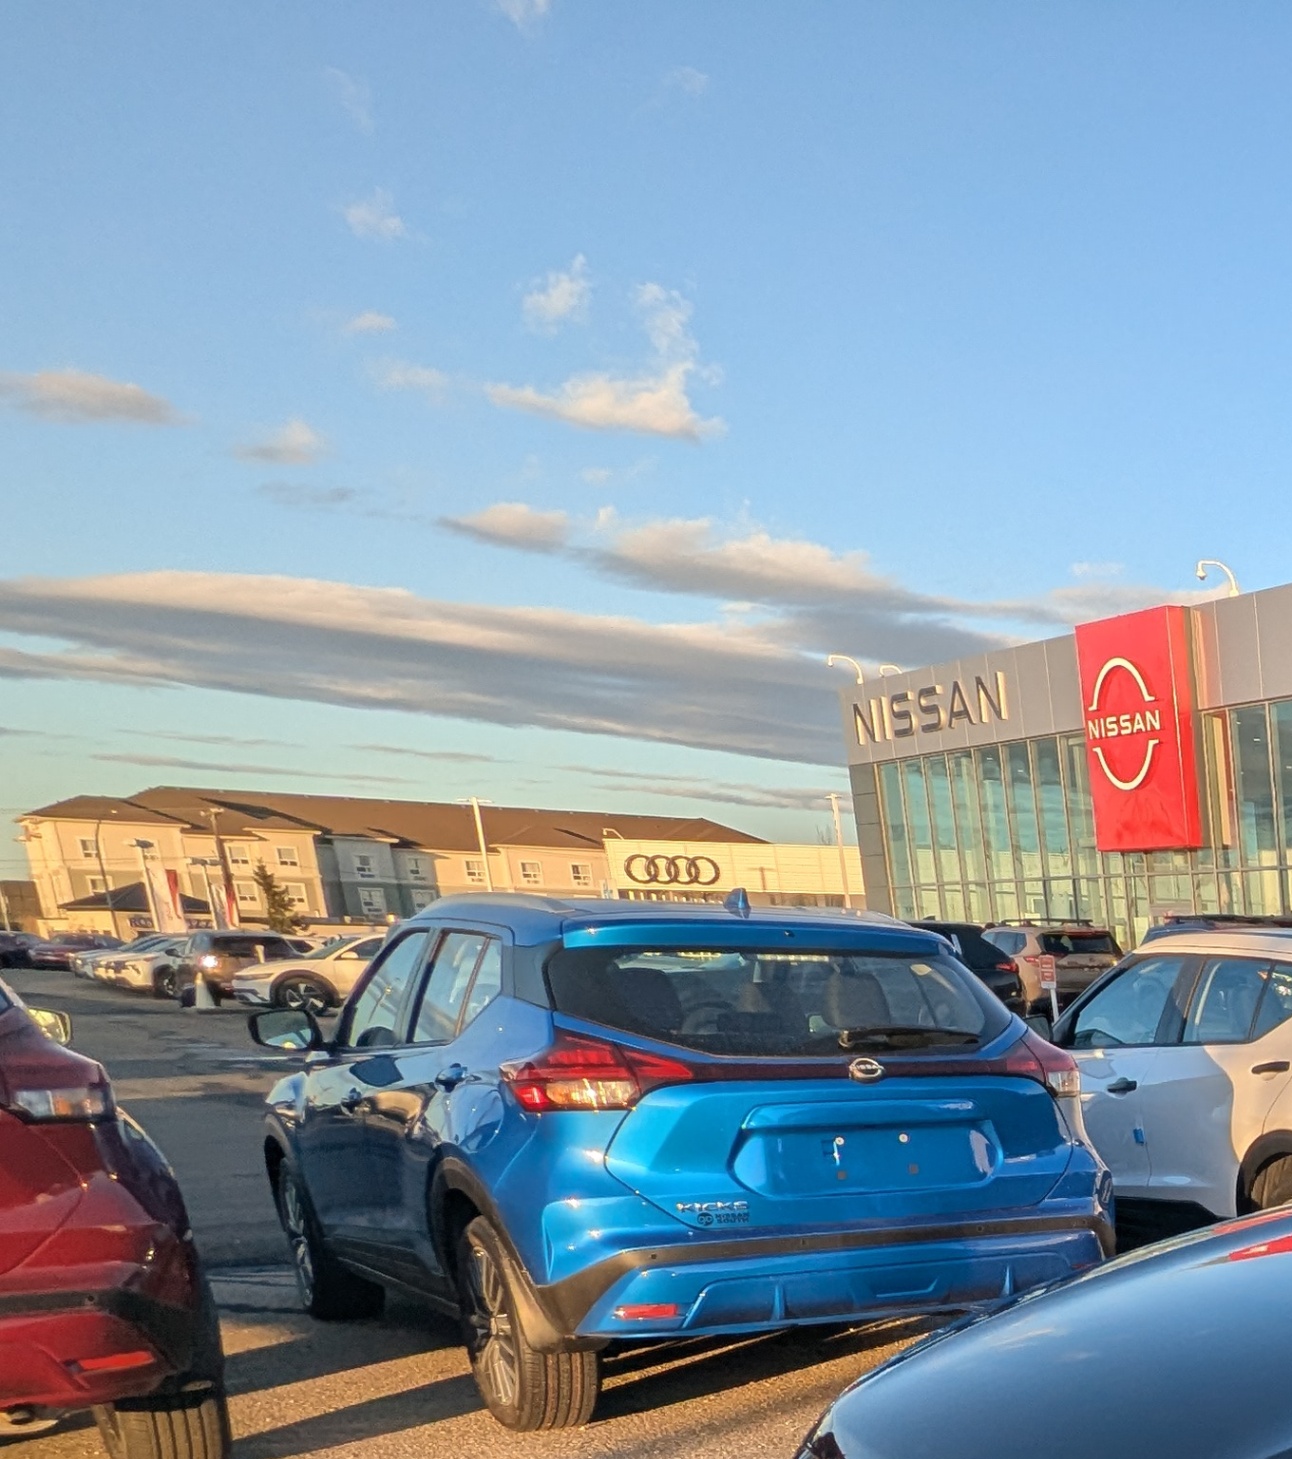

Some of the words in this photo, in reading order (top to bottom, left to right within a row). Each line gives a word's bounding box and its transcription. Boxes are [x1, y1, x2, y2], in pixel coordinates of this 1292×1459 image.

[852, 671, 1008, 745] NISSAN
[1088, 709, 1161, 740] NISSAN
[676, 1201, 748, 1212] KICKS
